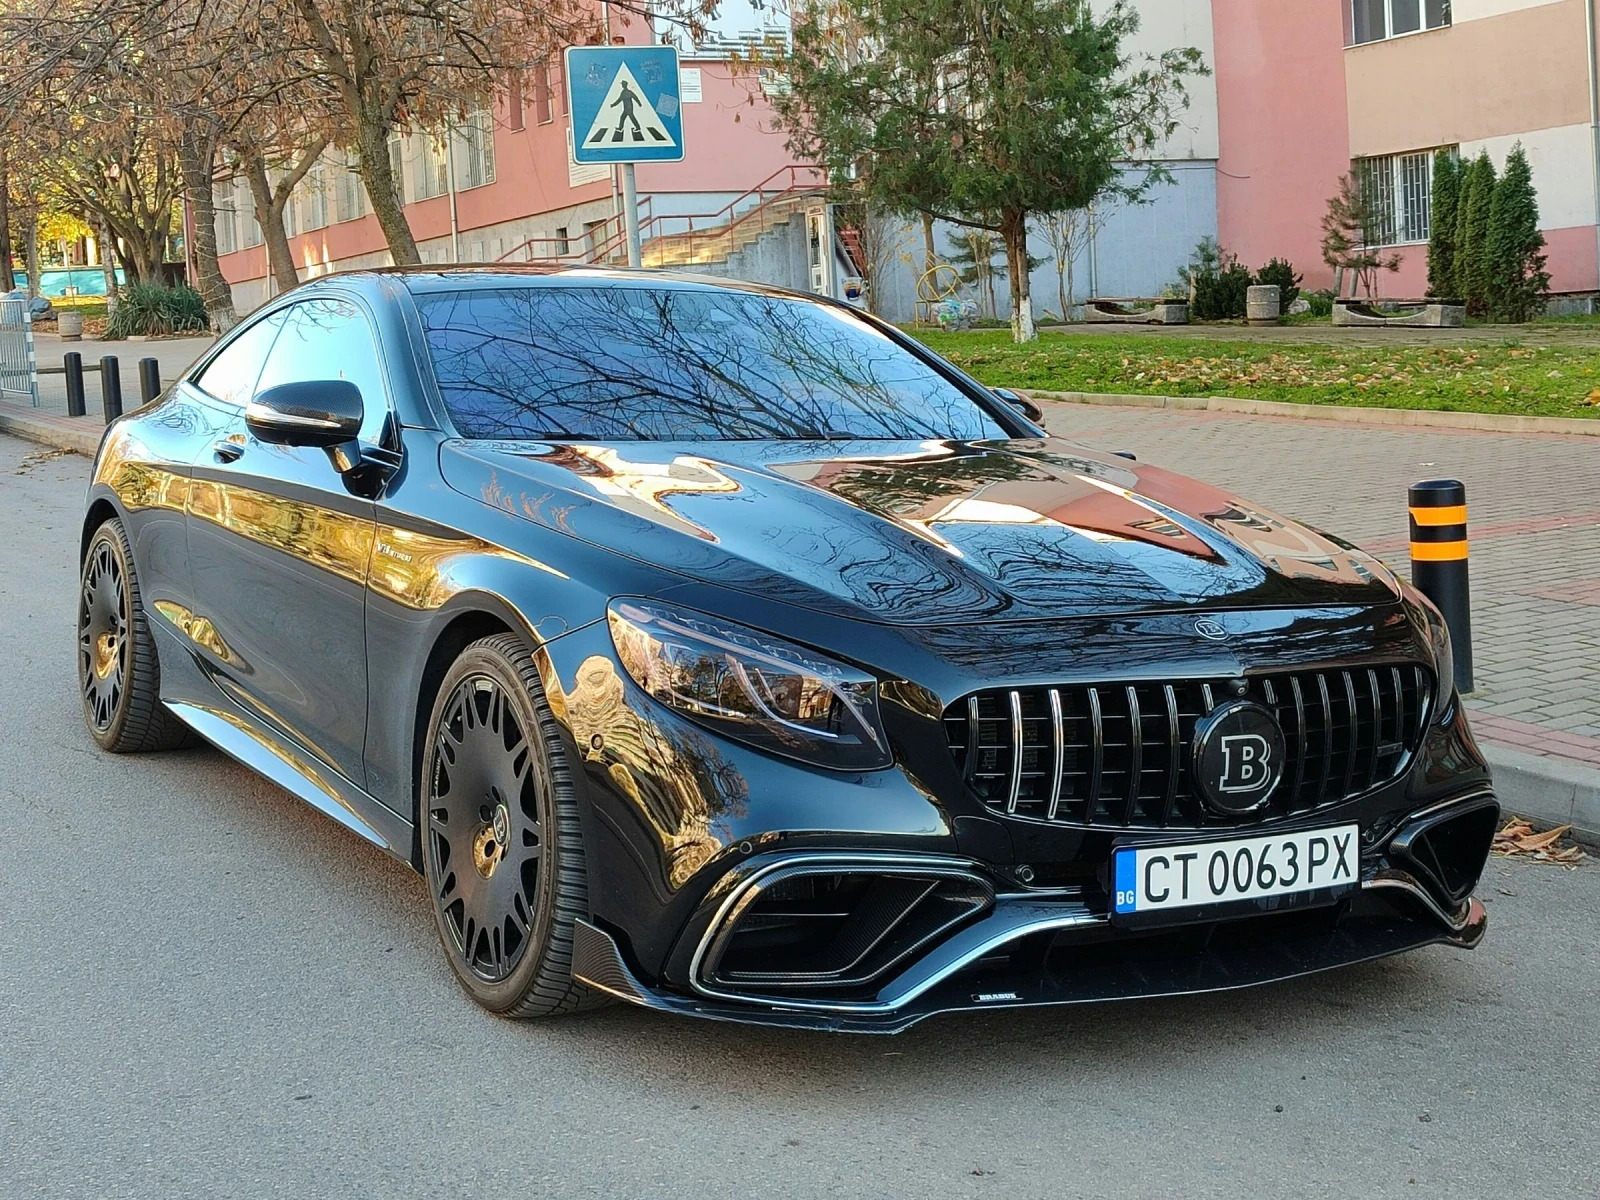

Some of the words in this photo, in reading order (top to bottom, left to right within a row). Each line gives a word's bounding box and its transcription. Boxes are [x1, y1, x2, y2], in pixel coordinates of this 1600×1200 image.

[1219, 734, 1271, 793] B
[1144, 852, 1198, 903] CT
[1208, 842, 1299, 896] 0063
[1307, 833, 1351, 883] PX
[1116, 890, 1134, 906] BG
[978, 992, 1017, 1001] BRABUS
